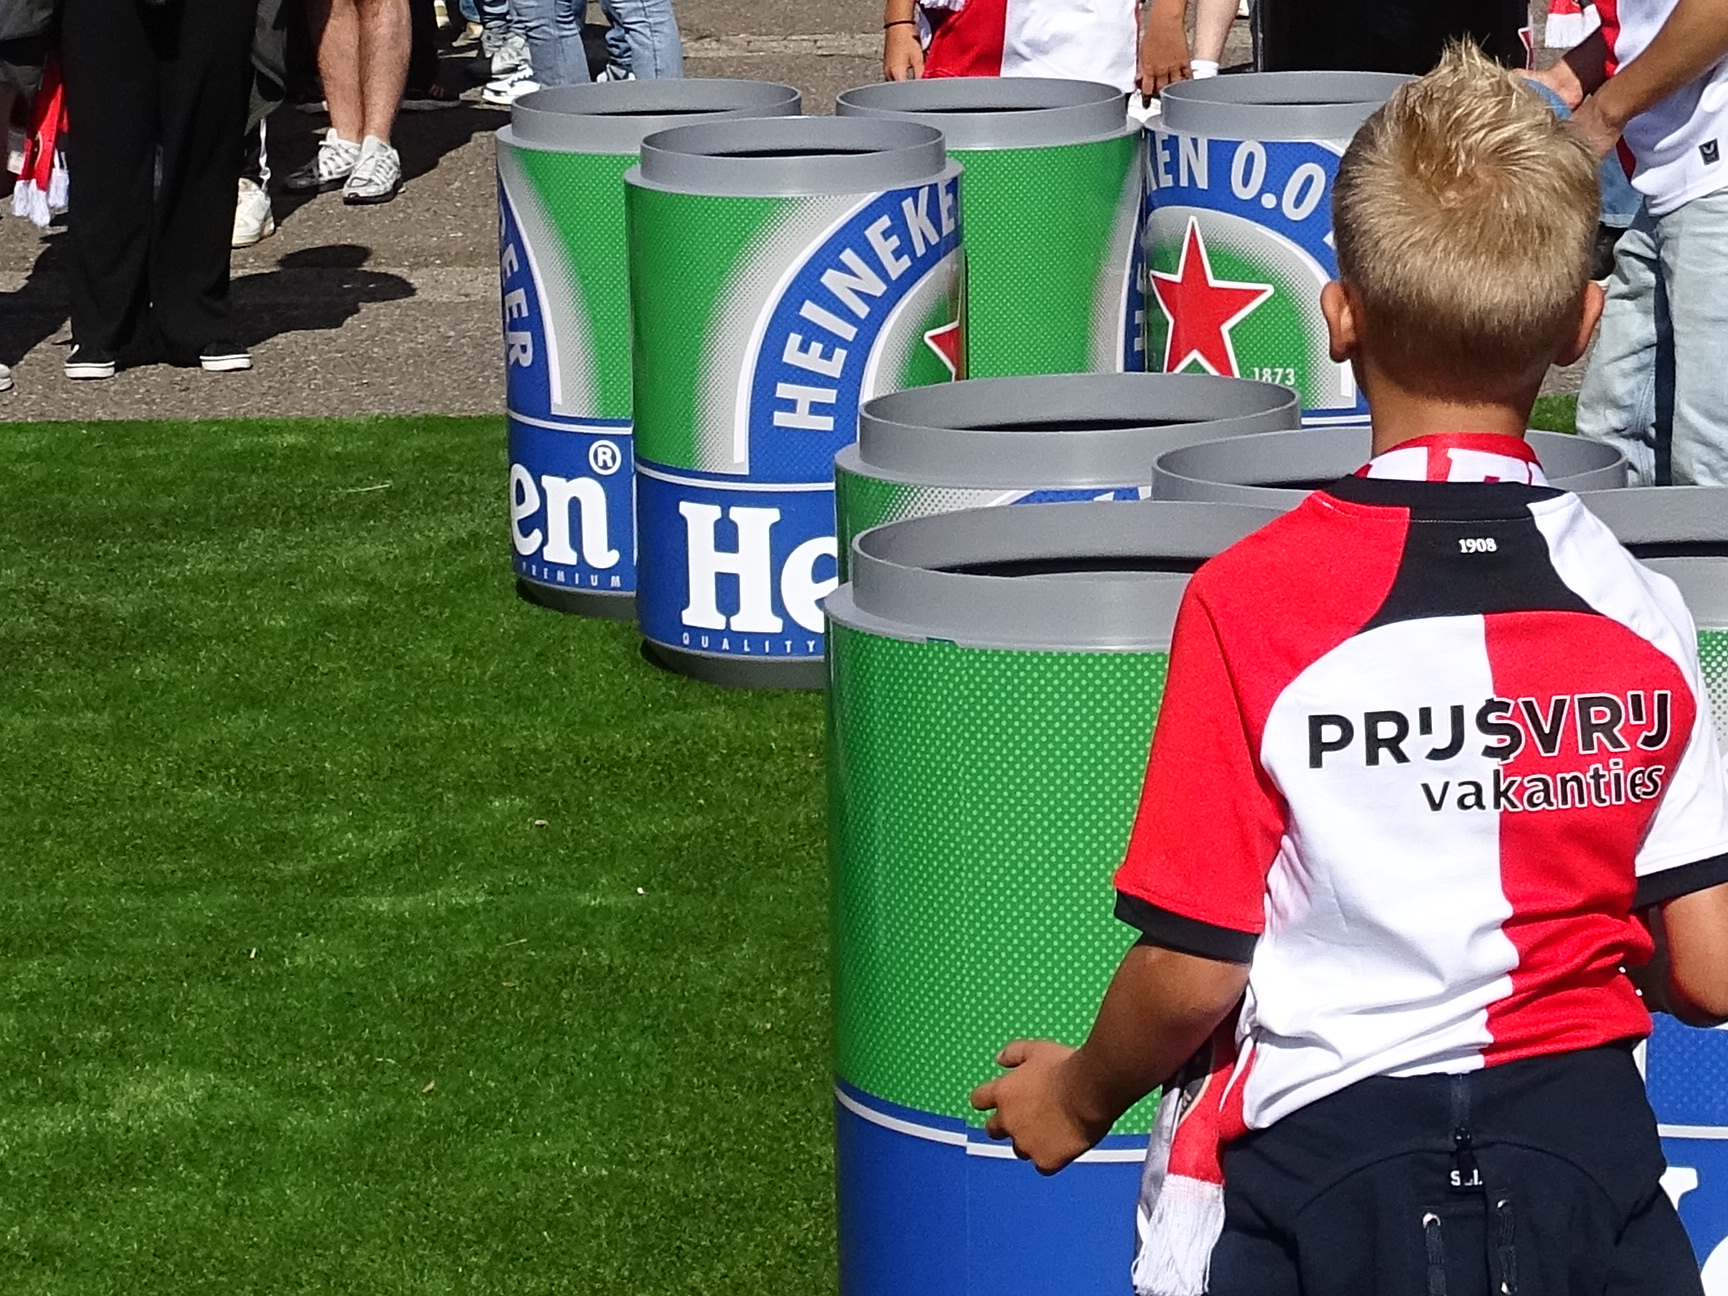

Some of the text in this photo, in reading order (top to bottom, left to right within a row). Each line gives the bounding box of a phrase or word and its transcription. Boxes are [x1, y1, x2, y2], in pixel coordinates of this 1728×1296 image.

[1231, 140, 1326, 221] 0.0
[1253, 367, 1296, 385] 1873
[1458, 538, 1497, 554] 1908
[683, 632, 816, 653] QUALITY
[1421, 760, 1665, 812] vakanties
